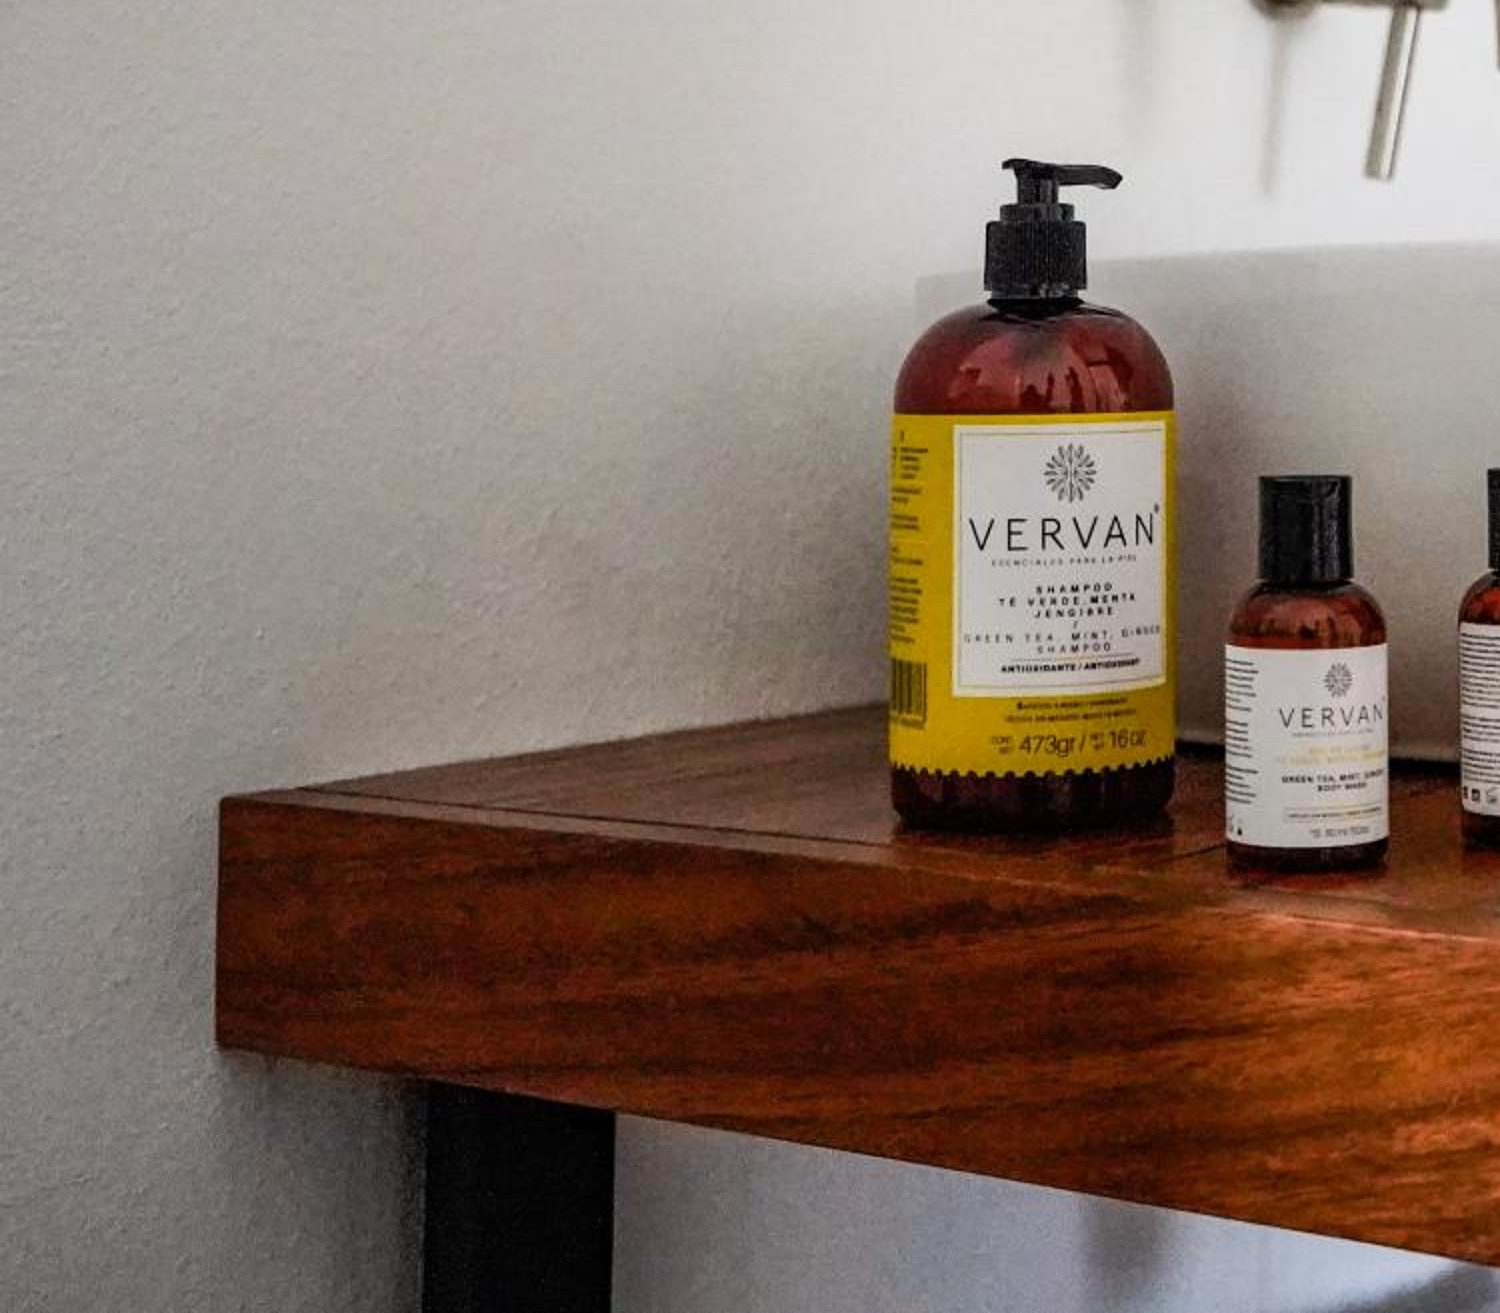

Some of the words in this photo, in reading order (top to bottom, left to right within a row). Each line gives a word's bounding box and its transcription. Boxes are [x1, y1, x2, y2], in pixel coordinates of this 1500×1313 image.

[969, 513, 1154, 551] VERVAN
[1036, 582, 1113, 594] SHAMPOO
[1037, 642, 1111, 655] SHAMPOO
[1279, 703, 1383, 729] VERVAN
